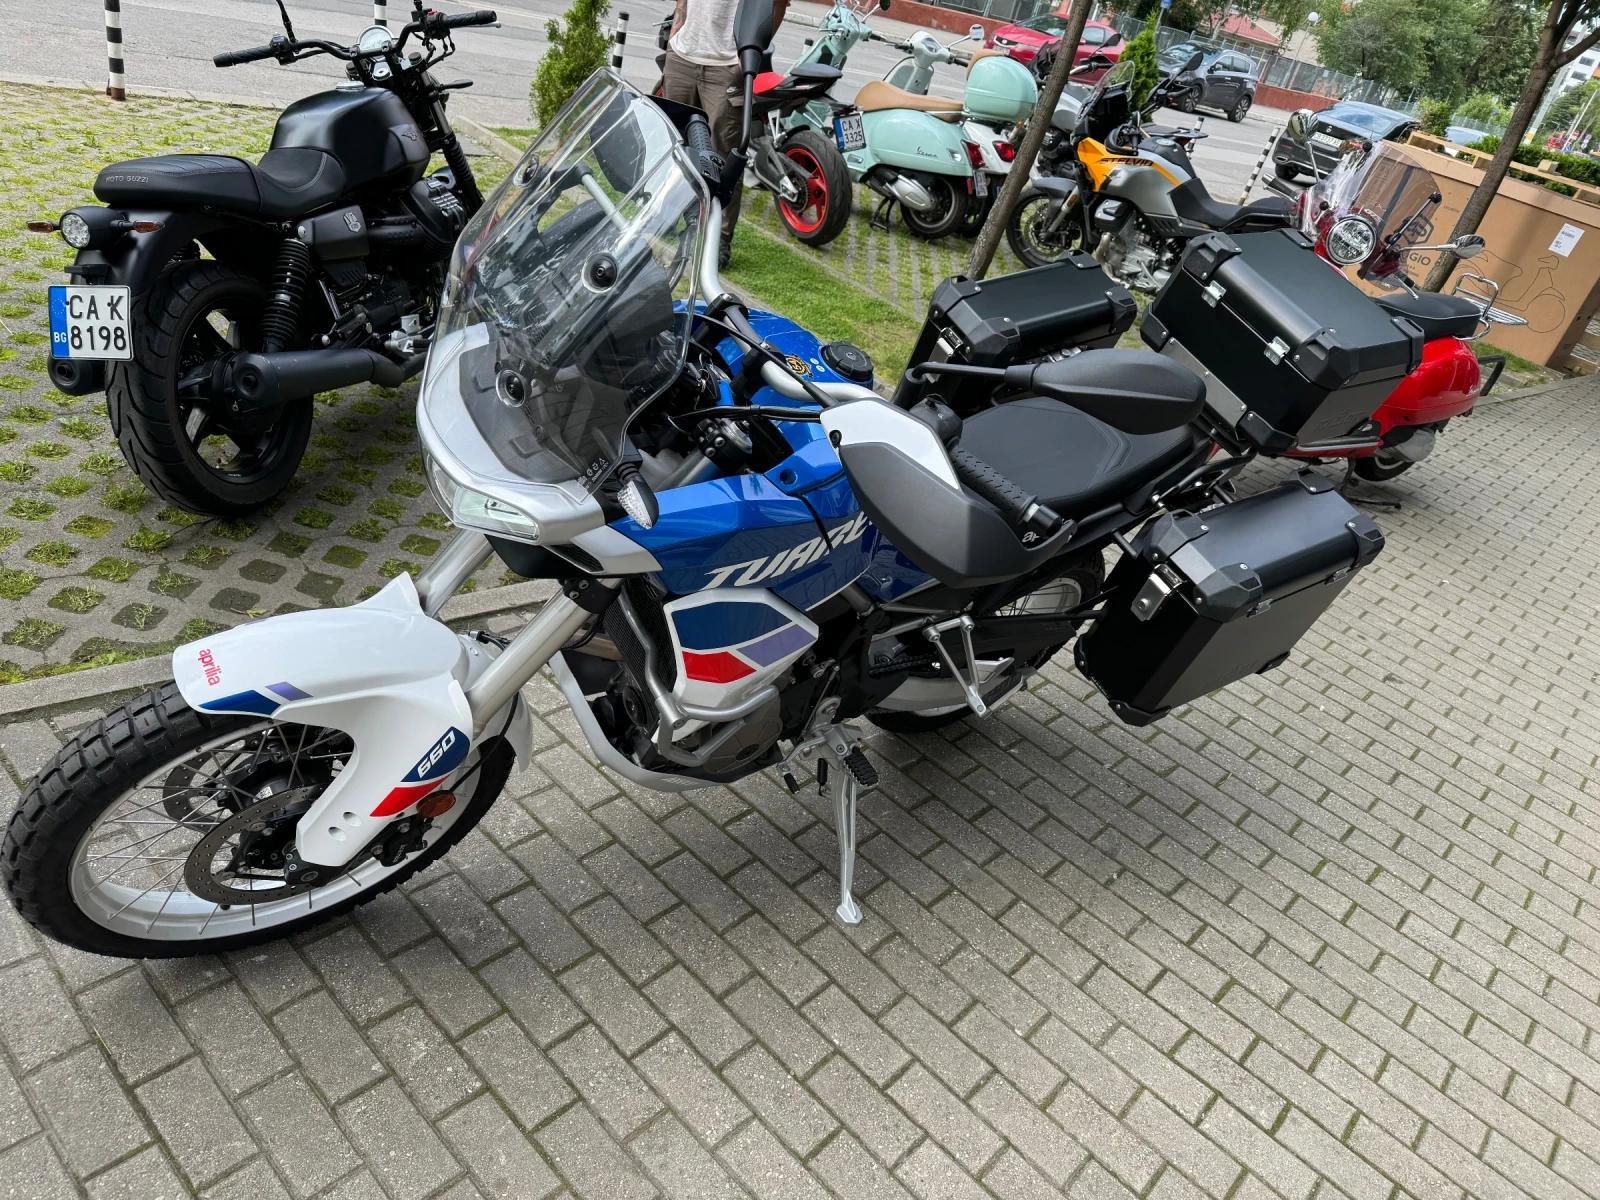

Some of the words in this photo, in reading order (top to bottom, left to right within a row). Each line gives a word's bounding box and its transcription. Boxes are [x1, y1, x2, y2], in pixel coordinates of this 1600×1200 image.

[842, 120, 853, 131] CA
[844, 131, 863, 144] 3325
[1099, 157, 1154, 167] STELVIO
[105, 175, 124, 183] MOTO
[126, 175, 149, 183] GUZZI
[69, 294, 100, 320] CA
[110, 295, 125, 320] K
[53, 332, 67, 343] BG
[70, 325, 127, 351] 8198
[699, 511, 873, 591] TUARE
[197, 648, 222, 687] aprilia
[417, 730, 456, 779] 660
